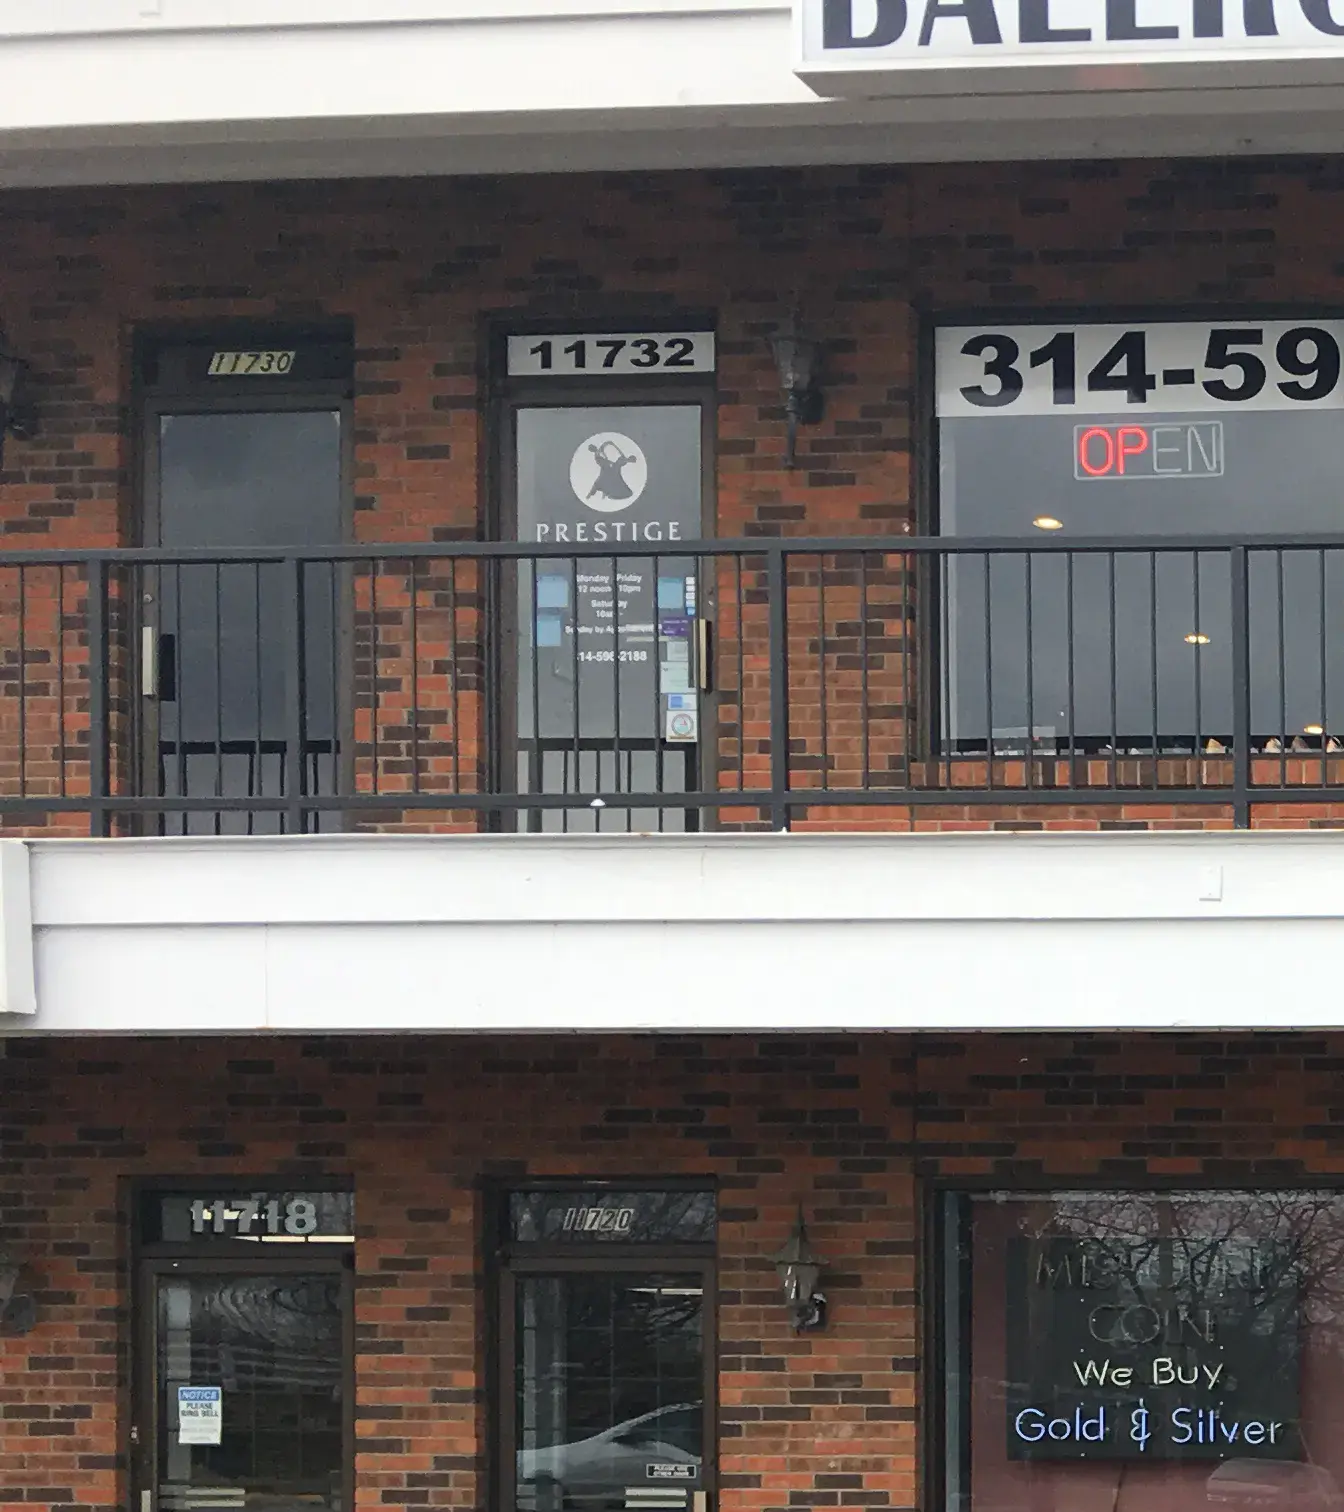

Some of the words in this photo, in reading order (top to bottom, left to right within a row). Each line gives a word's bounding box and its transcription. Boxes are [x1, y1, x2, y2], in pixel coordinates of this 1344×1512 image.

[215, 352, 292, 374] 11730
[530, 338, 695, 369] 11732
[1078, 424, 1221, 476] OPEN
[536, 521, 682, 542] PRESTIGE
[190, 1199, 317, 1234] 11718
[563, 1208, 635, 1231] 11720
[1073, 1359, 1134, 1387] We
[1153, 1357, 1223, 1390] Buy
[182, 1390, 218, 1400] NOTICE
[1015, 1405, 1105, 1442] Gold
[1130, 1398, 1152, 1452] &
[1171, 1407, 1282, 1444] Silver
